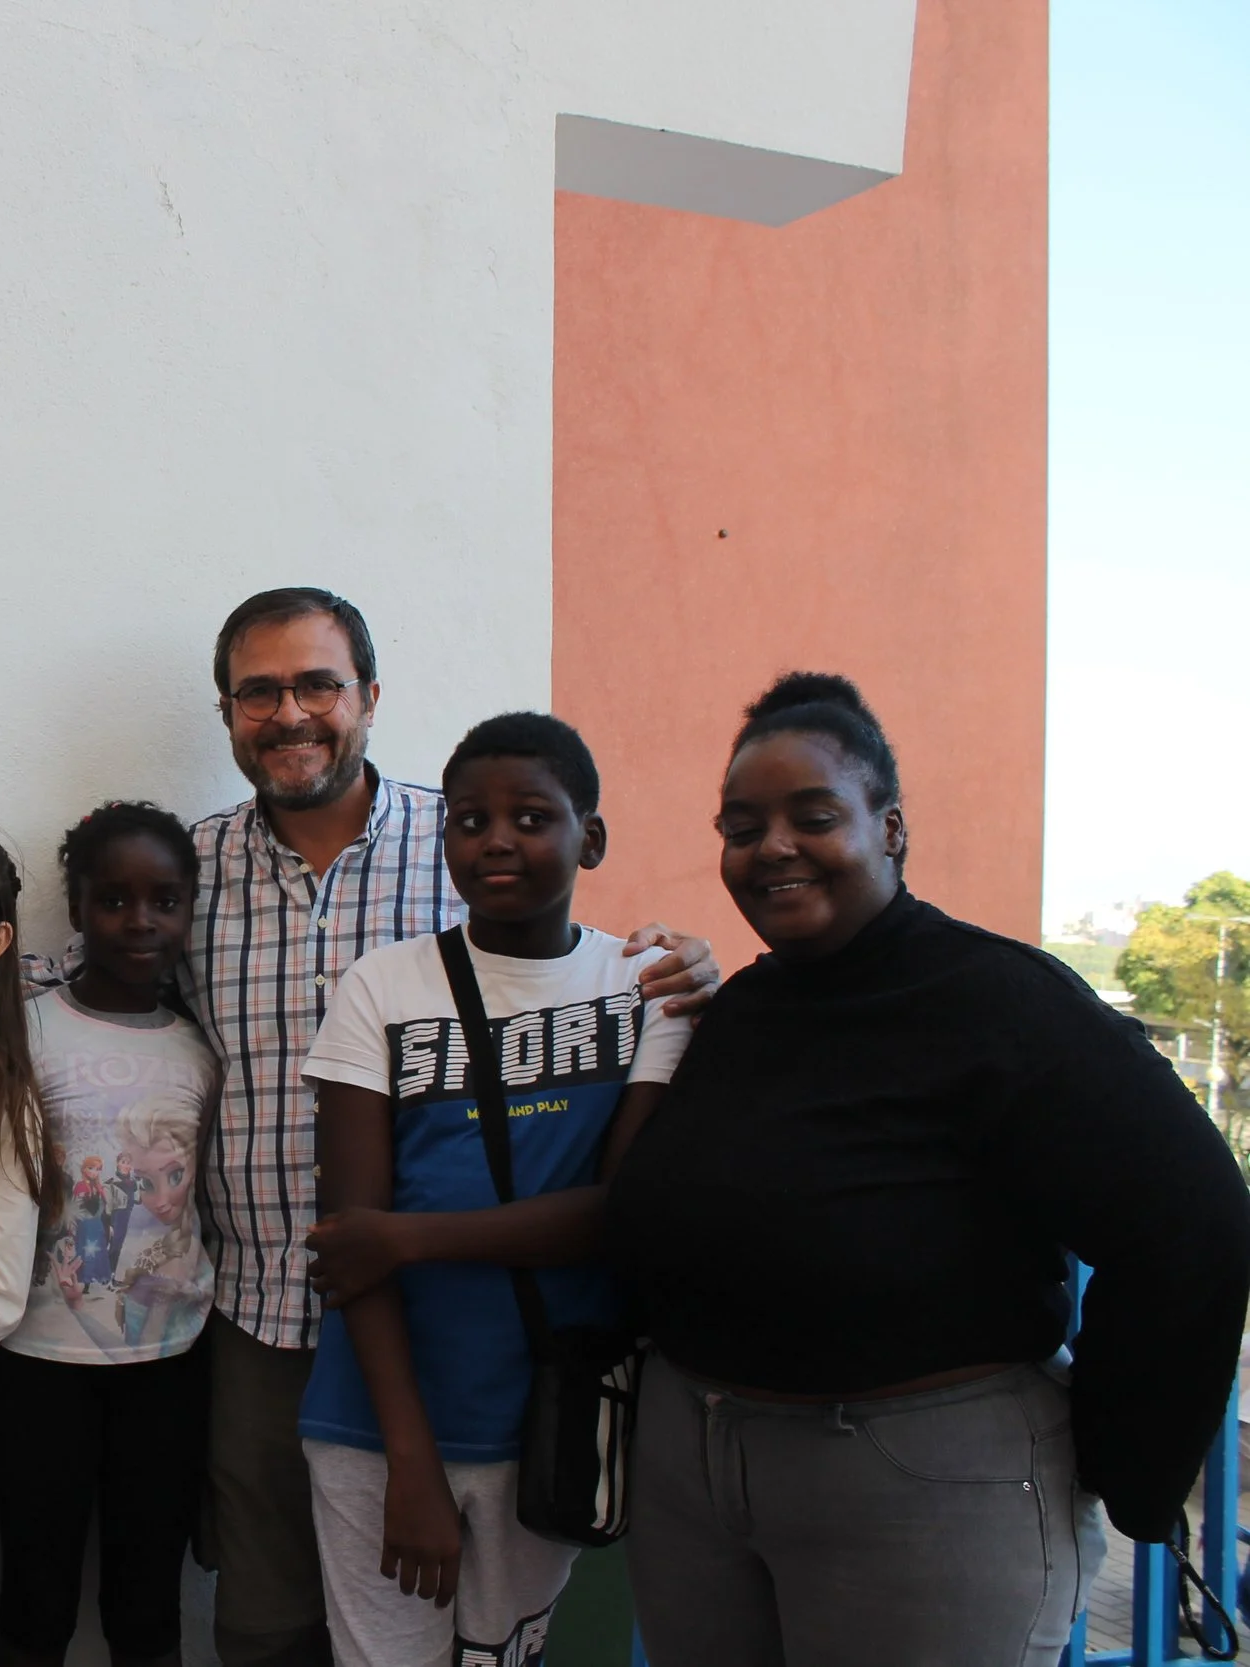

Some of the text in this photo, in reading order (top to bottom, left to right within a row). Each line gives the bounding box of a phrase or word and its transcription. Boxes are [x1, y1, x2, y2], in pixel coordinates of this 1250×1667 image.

[397, 985, 641, 1099] SPORT
[508, 1099, 569, 1117] AND PLAY
